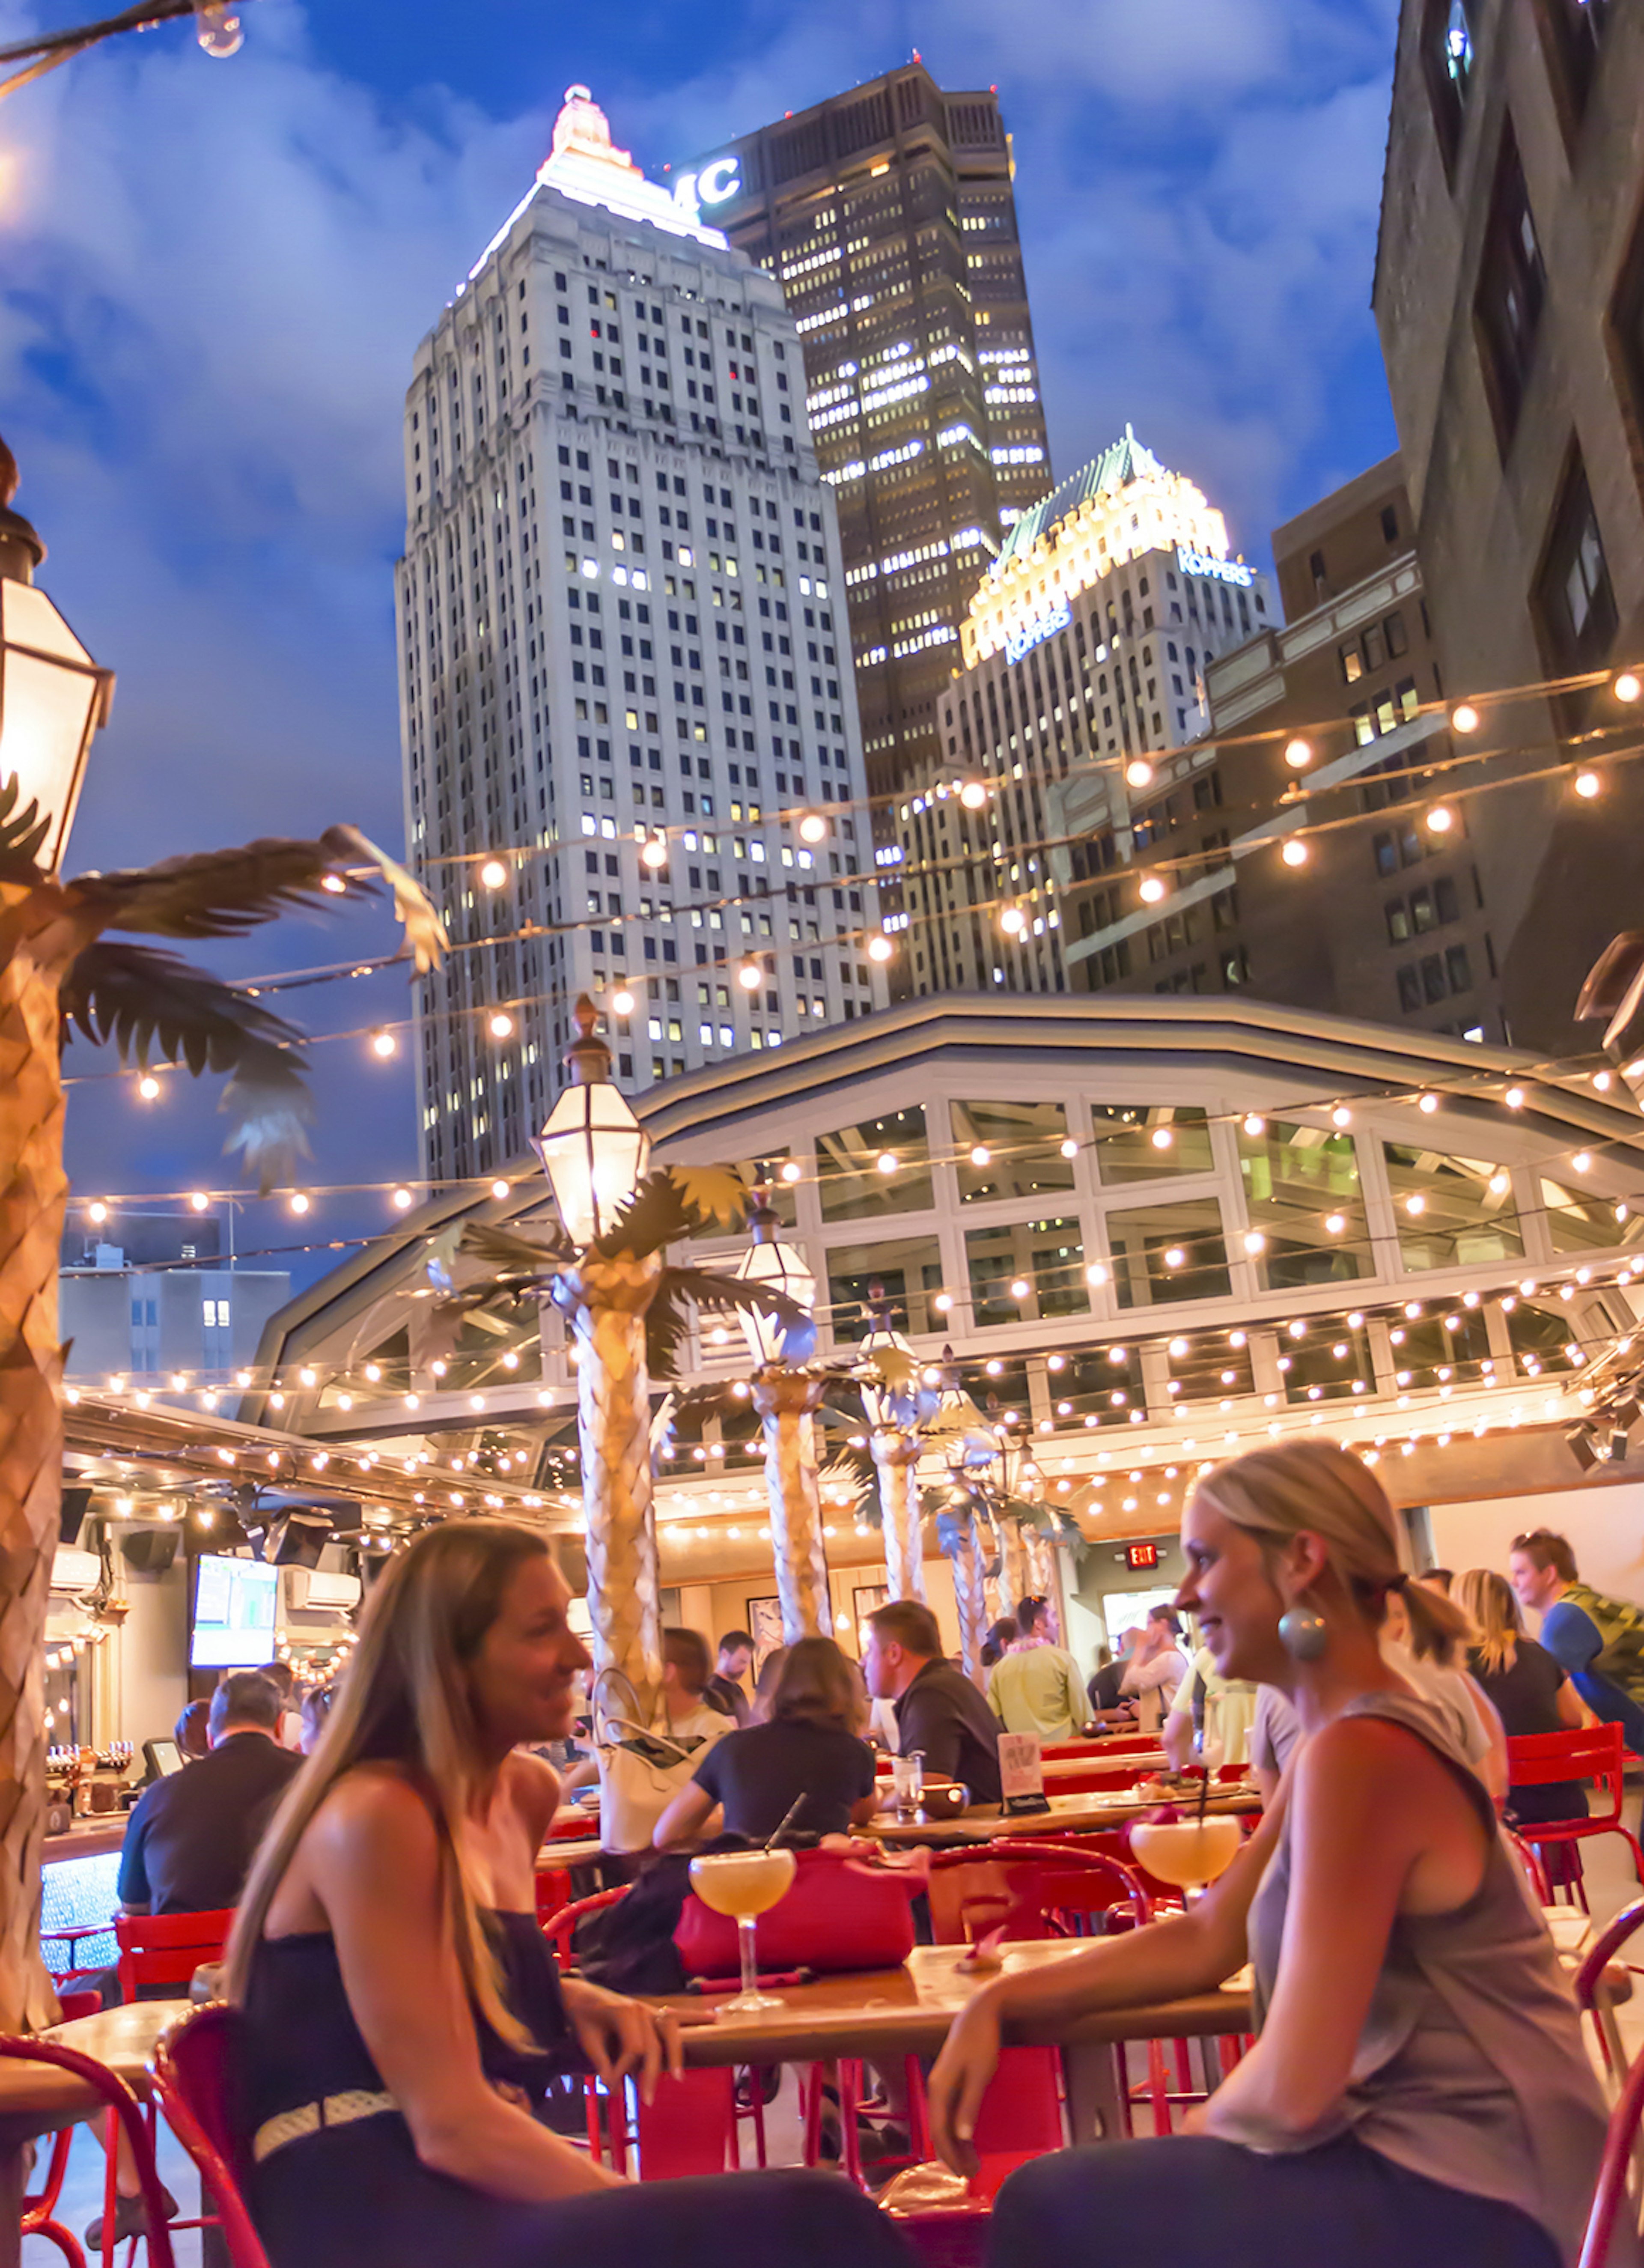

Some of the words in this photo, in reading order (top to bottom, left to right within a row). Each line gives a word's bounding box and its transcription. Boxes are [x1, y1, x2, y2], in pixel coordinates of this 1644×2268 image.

[1177, 546, 1253, 587] KOPPERS
[1005, 606, 1072, 665] KOPPERS
[1131, 1545, 1153, 1565] EXIT
